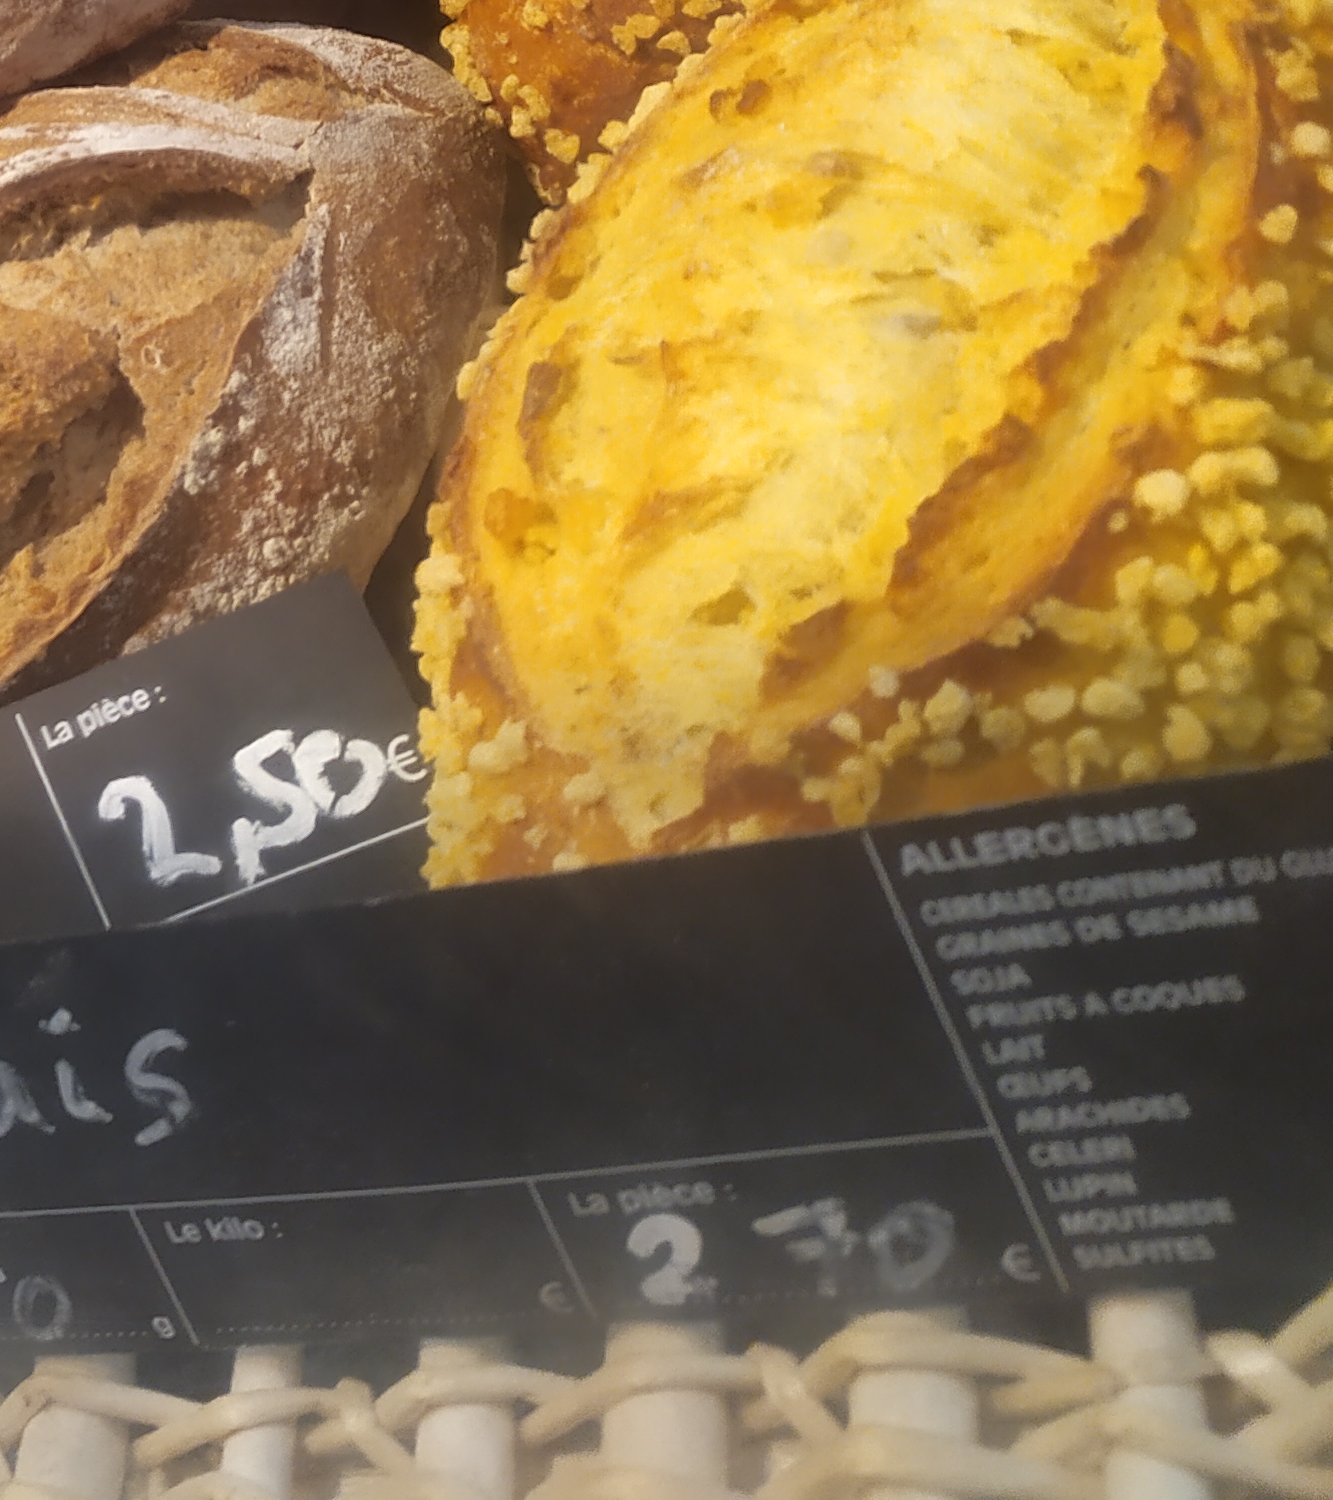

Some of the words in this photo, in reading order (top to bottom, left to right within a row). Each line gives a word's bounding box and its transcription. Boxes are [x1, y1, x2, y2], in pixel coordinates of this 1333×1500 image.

[40, 719, 73, 750] La
[75, 686, 152, 739] pièce
[566, 1191, 610, 1218] La
[617, 1179, 715, 1216] pièce
[164, 1219, 202, 1245] Le
[206, 1215, 265, 1243] kilo
